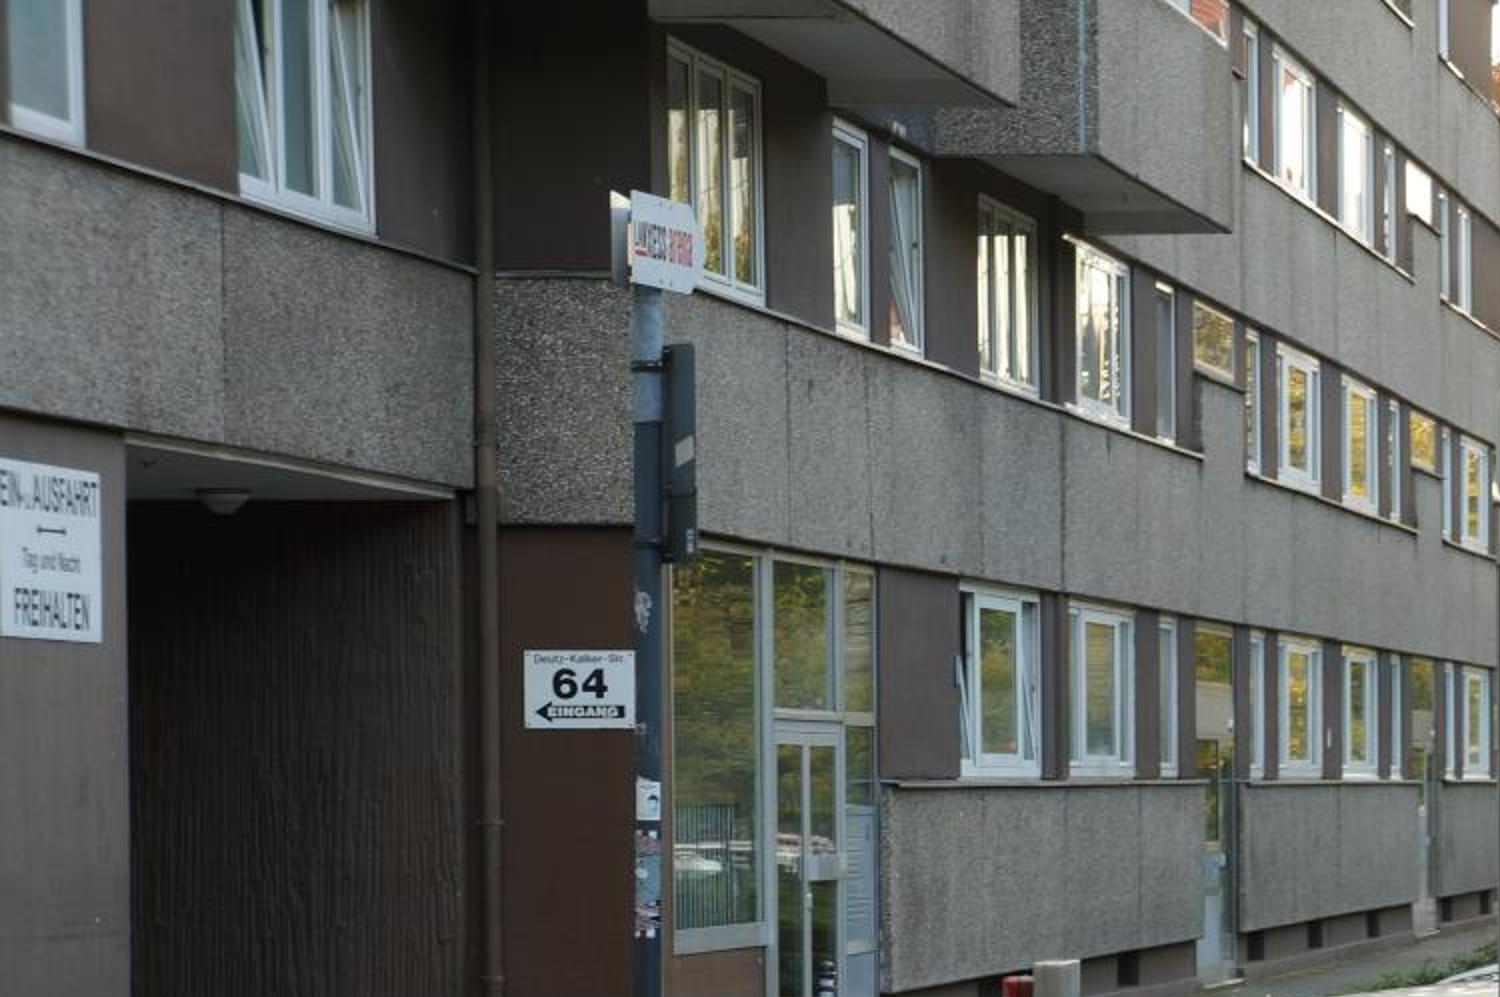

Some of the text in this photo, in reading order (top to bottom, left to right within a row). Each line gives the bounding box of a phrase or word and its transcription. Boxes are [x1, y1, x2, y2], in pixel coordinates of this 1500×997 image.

[15, 586, 91, 630] FREIHALTEN
[552, 668, 609, 699] 64
[547, 706, 619, 718] EINGANG
